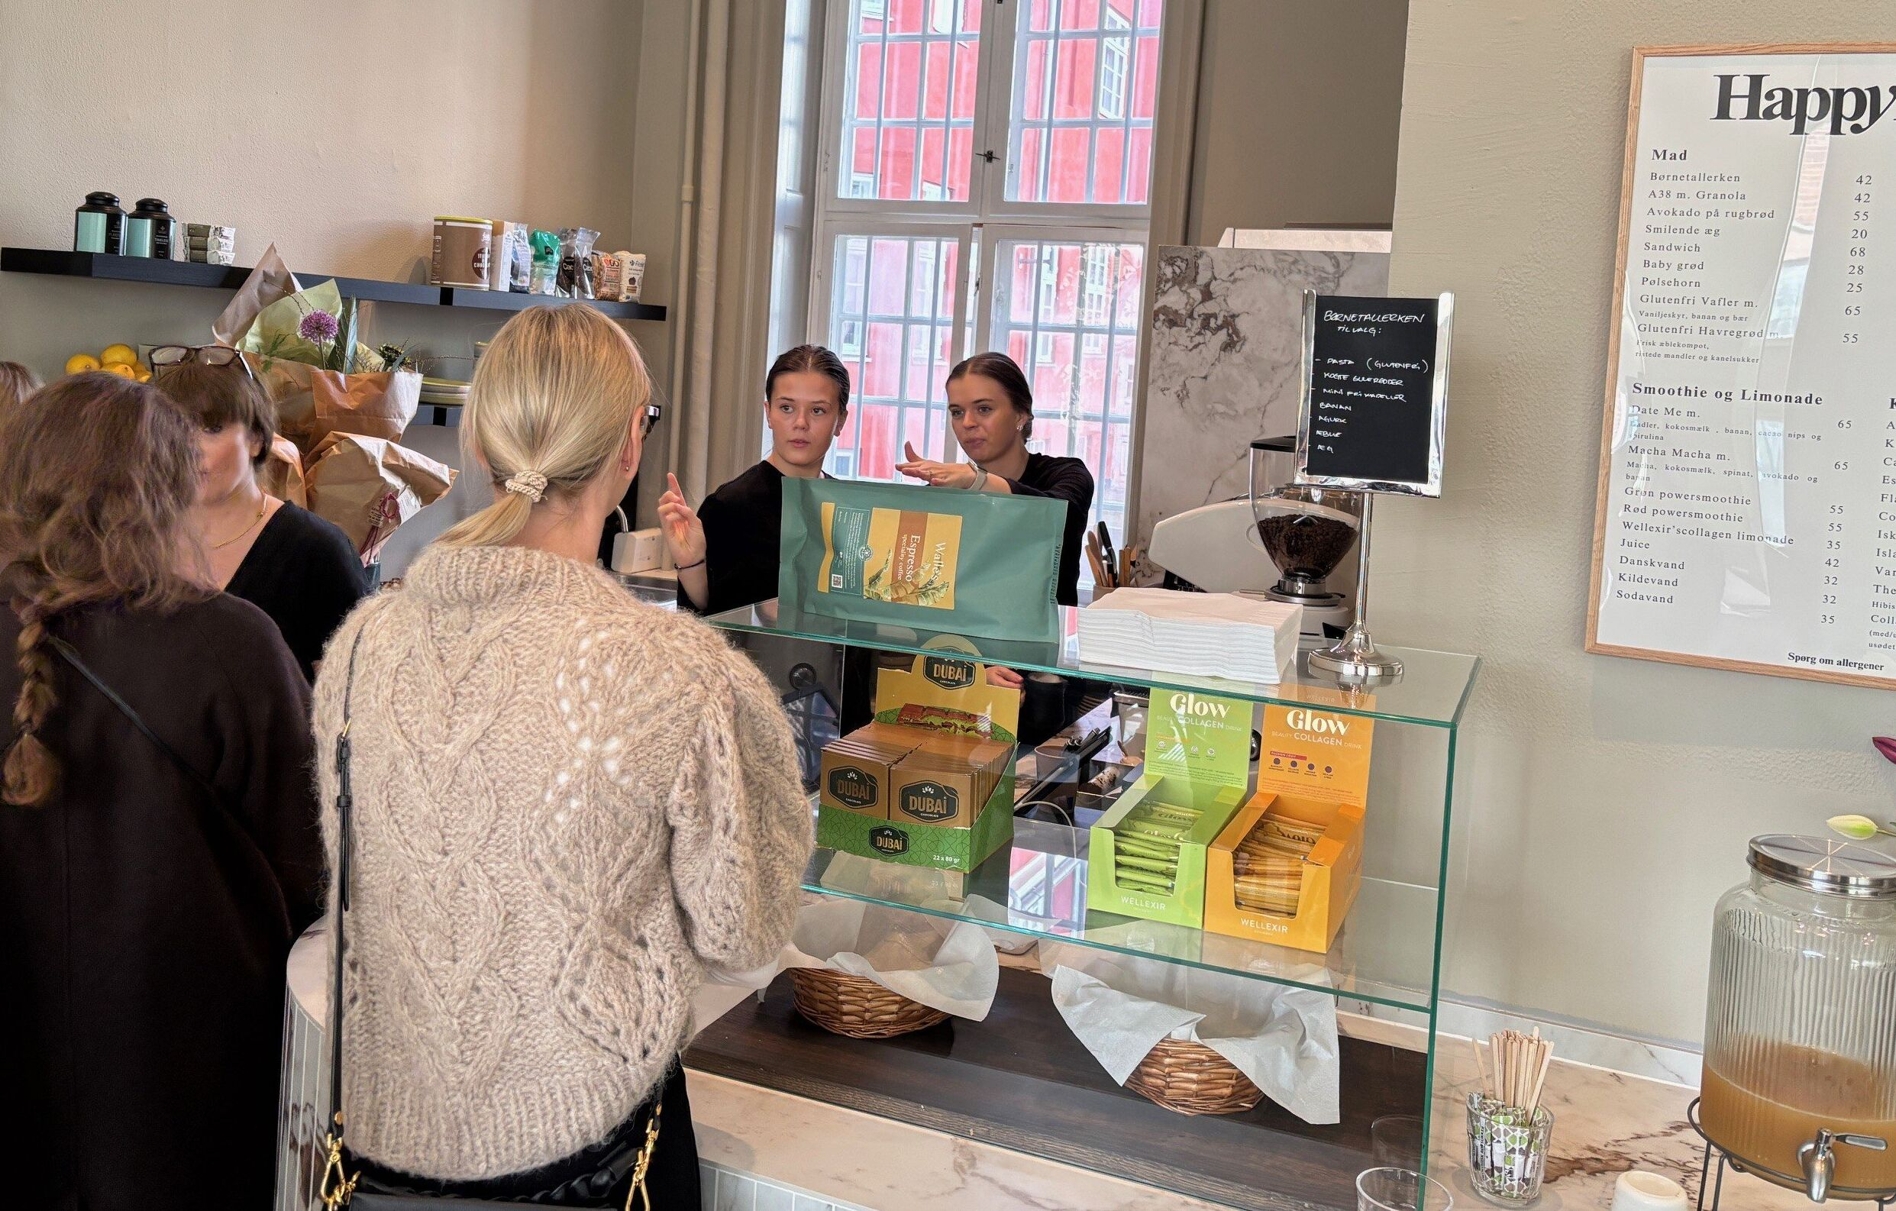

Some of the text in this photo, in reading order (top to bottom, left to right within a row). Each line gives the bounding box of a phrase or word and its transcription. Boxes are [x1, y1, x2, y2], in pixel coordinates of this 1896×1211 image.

[1652, 149, 1687, 160] Mad
[1651, 172, 1872, 185] Børnetallerken 42
[1648, 190, 1671, 198] A38
[1696, 191, 1745, 200] Granola
[1854, 193, 1870, 203] 42
[1647, 208, 1868, 221] Avokado på rugbrød 55
[1646, 225, 1699, 234] Smilende
[1852, 229, 1867, 239] 20
[1644, 242, 1865, 257] Sandwich 68
[1643, 260, 1864, 275] Baby grød 28
[1642, 277, 1862, 293] Pølsehorn 25
[1640, 295, 1695, 305] Glutenfri
[1702, 297, 1739, 306] Vafler
[1845, 306, 1860, 315] 65
[1639, 311, 1688, 319] Vaniljeskyr,
[1638, 324, 1692, 334] Glutenfri
[1699, 326, 1763, 339] Havregrød
[1843, 334, 1858, 343] 55
[1711, 354, 1760, 364] kanelsukker
[1633, 383, 1822, 405] Smoothie og Limonade
[1320, 402, 1352, 411] BANAN
[1664, 407, 1681, 416] Me
[1725, 427, 1752, 435] banan,
[1838, 420, 1851, 429] 65
[1628, 445, 1666, 456] Macha
[1672, 449, 1710, 459] Macha
[1834, 461, 1848, 470] 65
[1660, 492, 1750, 505] powersmoothie
[1624, 504, 1743, 522] Rød powersmoothie
[1830, 505, 1843, 514] 55
[1828, 523, 1842, 532] 55
[1737, 532, 1793, 544] limonade
[1827, 540, 1840, 549] 35
[904, 535, 922, 583] Espresso
[1621, 539, 1839, 567] Juice 42
[1620, 556, 1837, 585] Danskvand 32
[1619, 573, 1836, 604] Kildevand 32
[1617, 590, 1834, 624] Sodavand 35
[1788, 652, 1816, 667] Spørg
[1837, 659, 1884, 670] allergener
[1170, 694, 1230, 718] Glow
[1286, 710, 1350, 736] Glow
[1294, 733, 1342, 746] COLLAGEN
[1121, 896, 1166, 910] WELLEXIR
[1241, 918, 1288, 934] WELLEXIR
